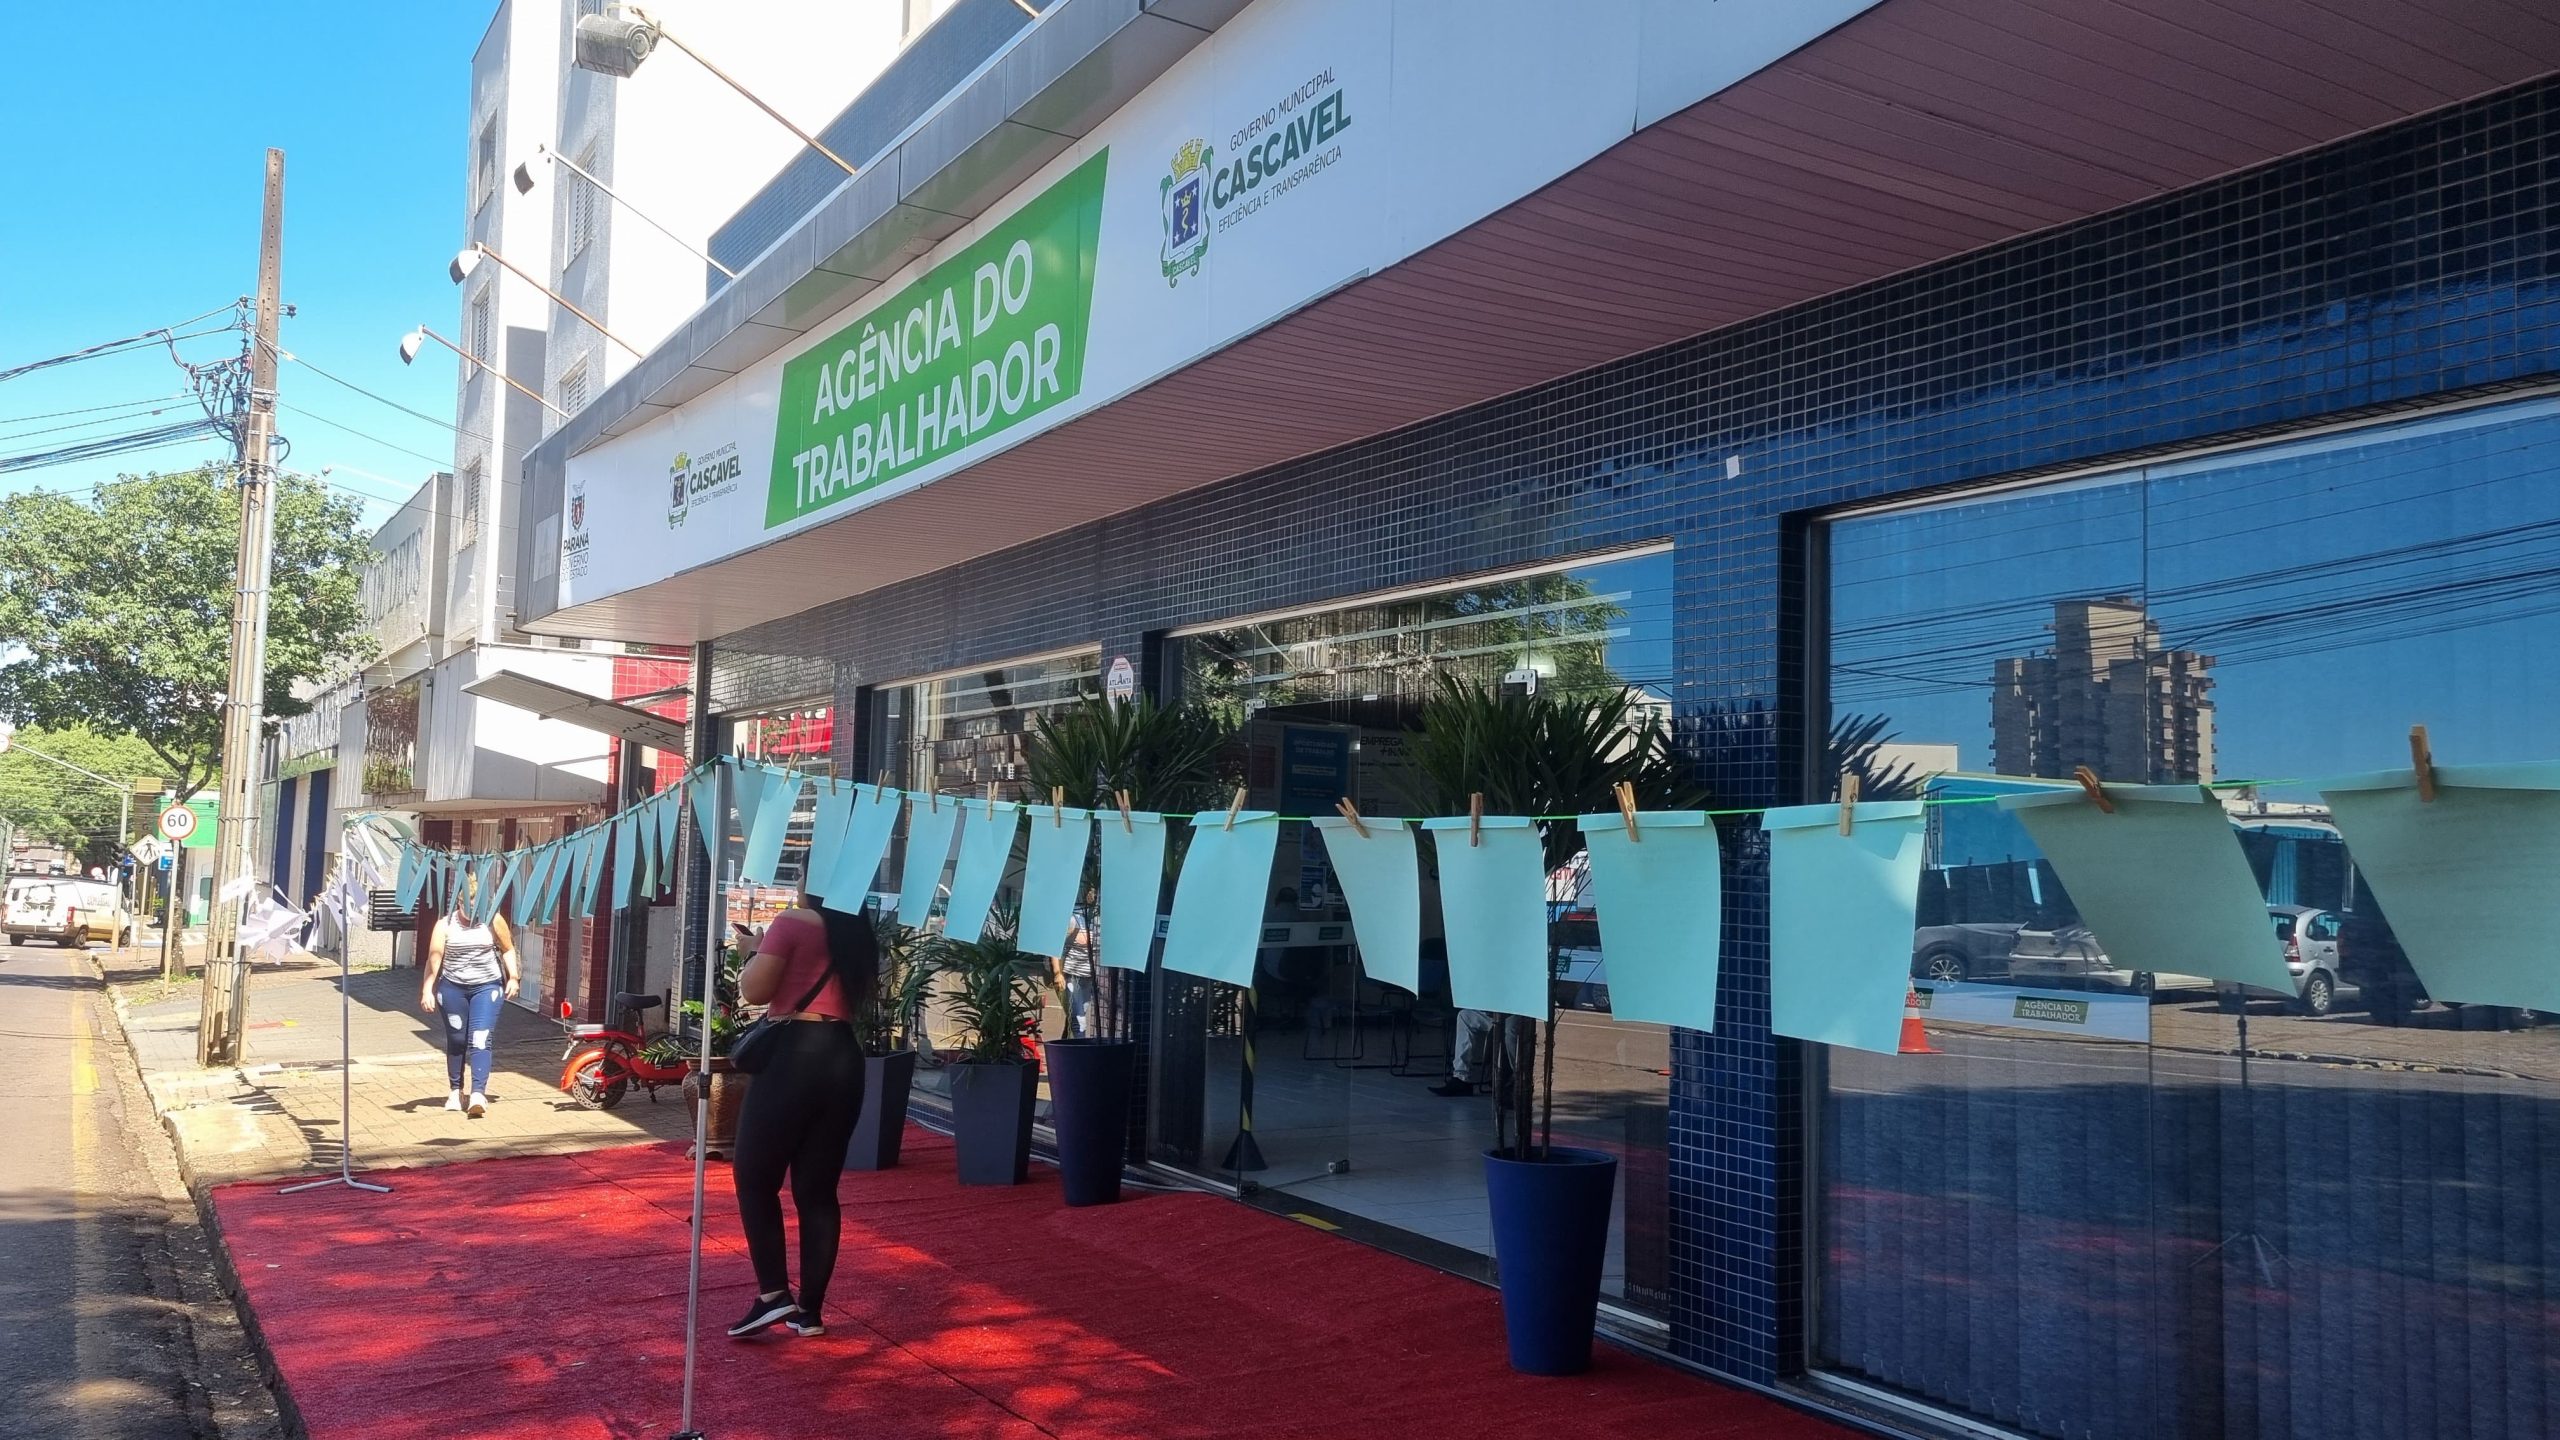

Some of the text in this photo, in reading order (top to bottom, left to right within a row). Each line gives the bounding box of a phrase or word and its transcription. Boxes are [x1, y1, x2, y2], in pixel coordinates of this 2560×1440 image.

[1230, 66, 1335, 151] GOVERNO MUNICIPAL
[1212, 88, 1352, 210] CASCAVEL
[1218, 145, 1342, 233] EFICIÊNCIA E TRANSPARÊNCIA
[812, 239, 1033, 424] AGÊNCIA DO
[793, 322, 1061, 509] TRABALHADOR
[689, 454, 742, 495] CASCAVEL
[563, 528, 590, 554] PARANÁ
[562, 551, 589, 571] GOVERNO
[569, 565, 588, 581] ESTADO
[1109, 673, 1132, 686] ATLANTA
[1360, 736, 1404, 747] EMPREGA
[167, 814, 188, 827] 60
[2021, 1009, 2081, 1022] TRABALHADOR
[2024, 1000, 2078, 1013] AGÊNCIA DO
